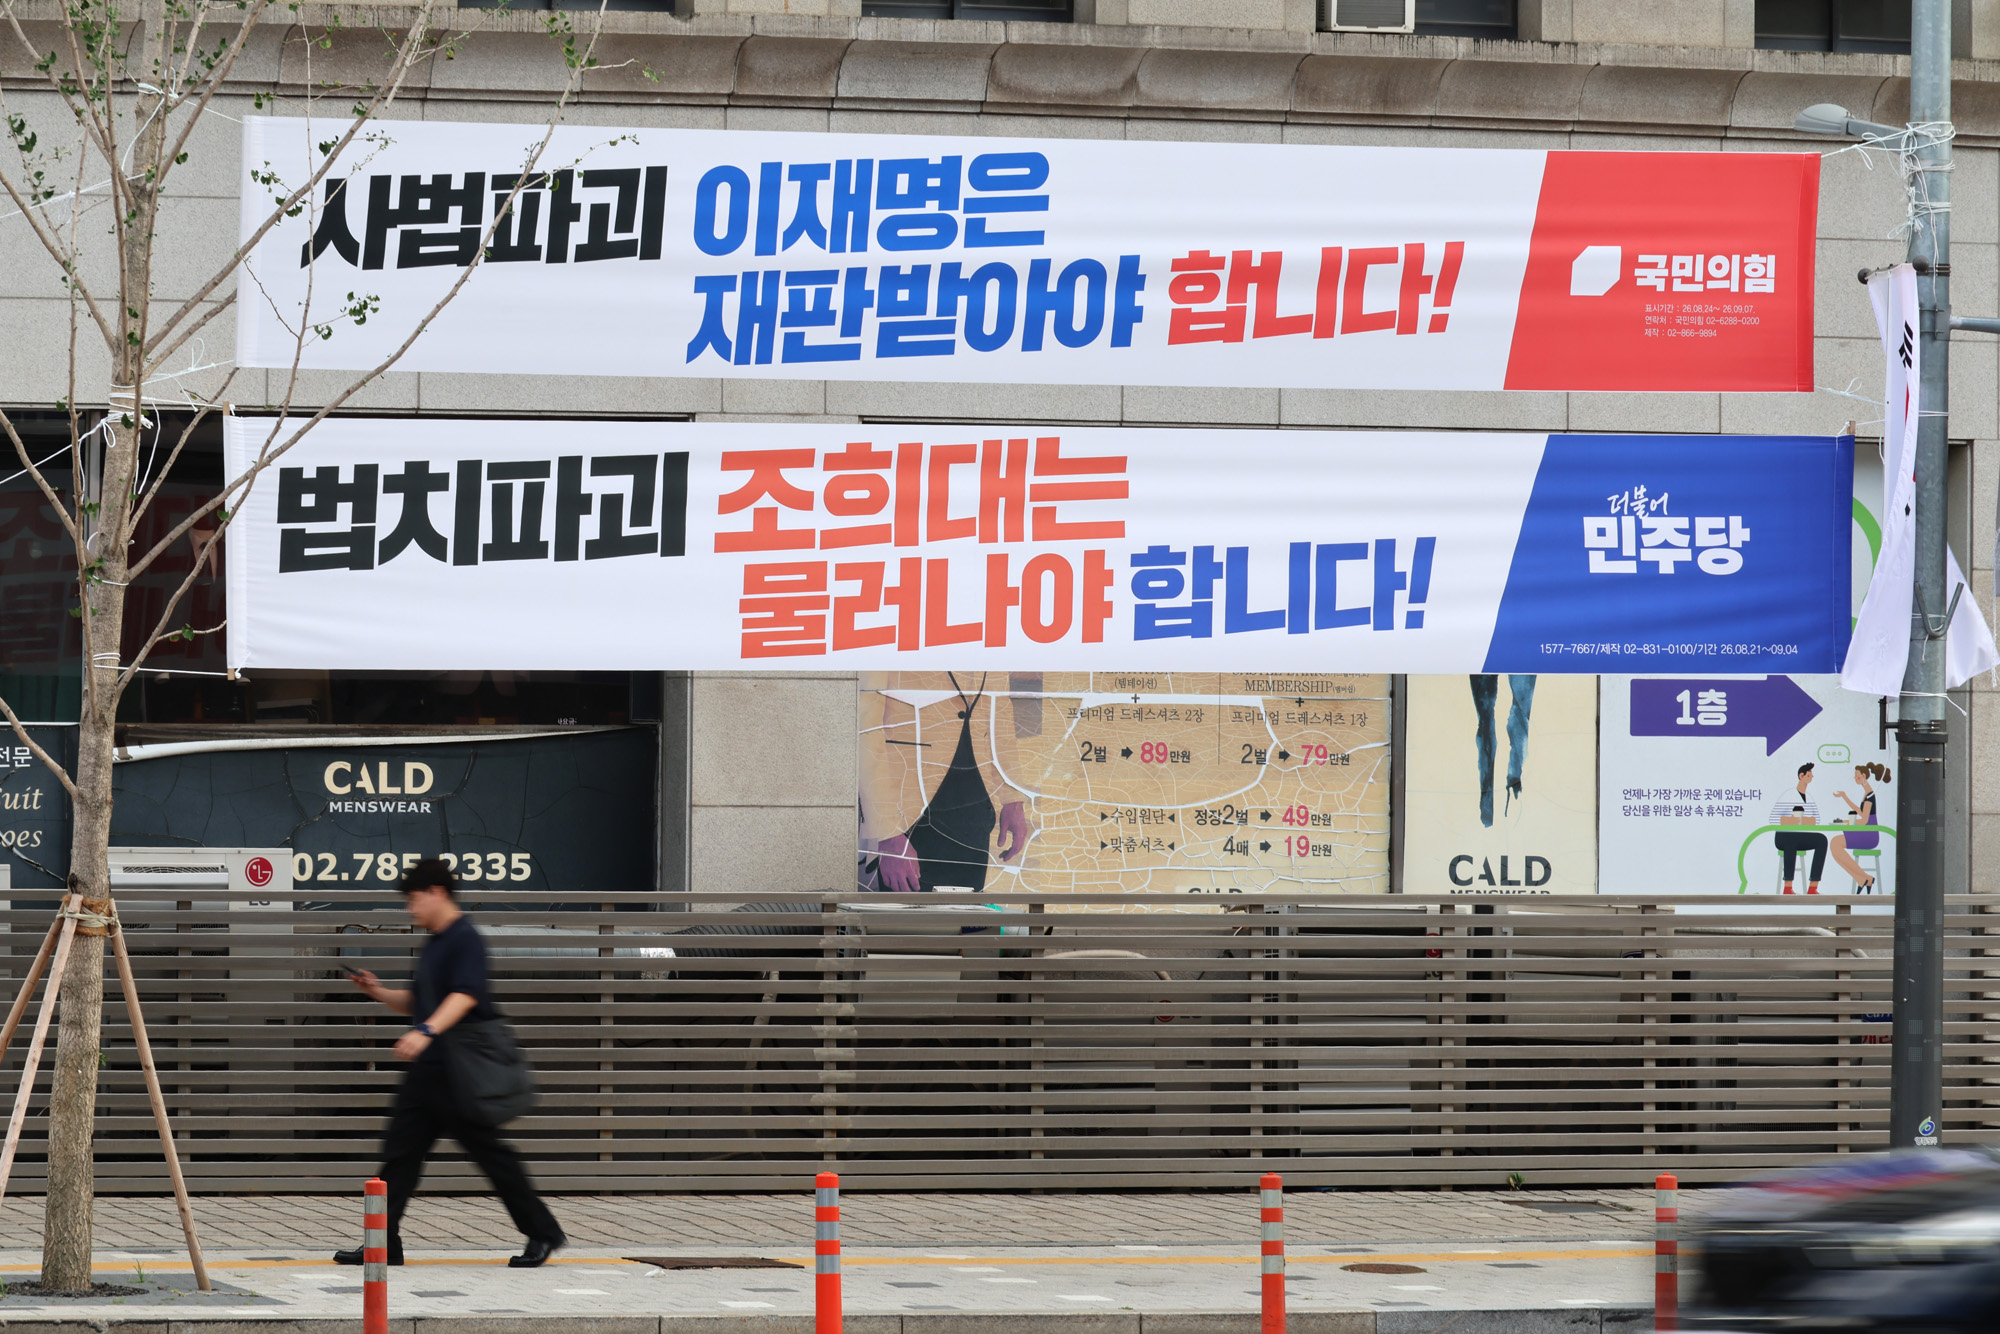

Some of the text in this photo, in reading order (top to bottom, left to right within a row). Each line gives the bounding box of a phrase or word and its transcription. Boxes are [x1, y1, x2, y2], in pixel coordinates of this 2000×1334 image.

[300, 151, 1050, 271] 사법파괴 이재명은
[1634, 253, 1776, 294] 국민의힘
[686, 240, 1465, 366] 재판받아야 합니다!
[1645, 303, 1674, 313] 표시기간
[1644, 315, 1667, 325] 연락처
[1675, 315, 1704, 325] 국민의힘
[1706, 316, 1760, 325] 02-6288-0200
[1644, 328, 1660, 338] 제작
[1667, 328, 1717, 337] 02-866-9894
[277, 451, 690, 574] 법치파괴
[714, 436, 1129, 554] 조희대는
[1607, 484, 1669, 520] 더불어
[1583, 515, 1751, 576] 민주당
[739, 536, 1437, 659] 물러나야 합니다!
[1540, 642, 1798, 656] 1577-7667/제작 02-831-0100/기간 26.08.21~09.04
[1114, 677, 1158, 690] (템테이션)
[1066, 707, 1204, 724] 프리미엄 드레스셔츠 2장
[1231, 710, 1368, 727] 프리미엄 드레스셔츠 1장
[1676, 688, 1728, 726] 1층
[1080, 741, 1191, 764] 2벌 89만원
[1241, 743, 1350, 766] 2벌 79만원
[323, 760, 435, 795] CALD
[0, 786, 44, 810] uit
[1622, 788, 1762, 801] 언제나 가장 가까운 곳에 있습니다
[328, 801, 432, 814] MENSWEAR
[1110, 807, 1166, 825] 수입원단
[1282, 805, 1332, 827] 49만원
[1622, 804, 1744, 817] 당신을 위한 일상 속 휴식공간
[1110, 835, 1332, 857] 맞춤셔츠 4매 19만원
[1448, 854, 1552, 887] CALD
